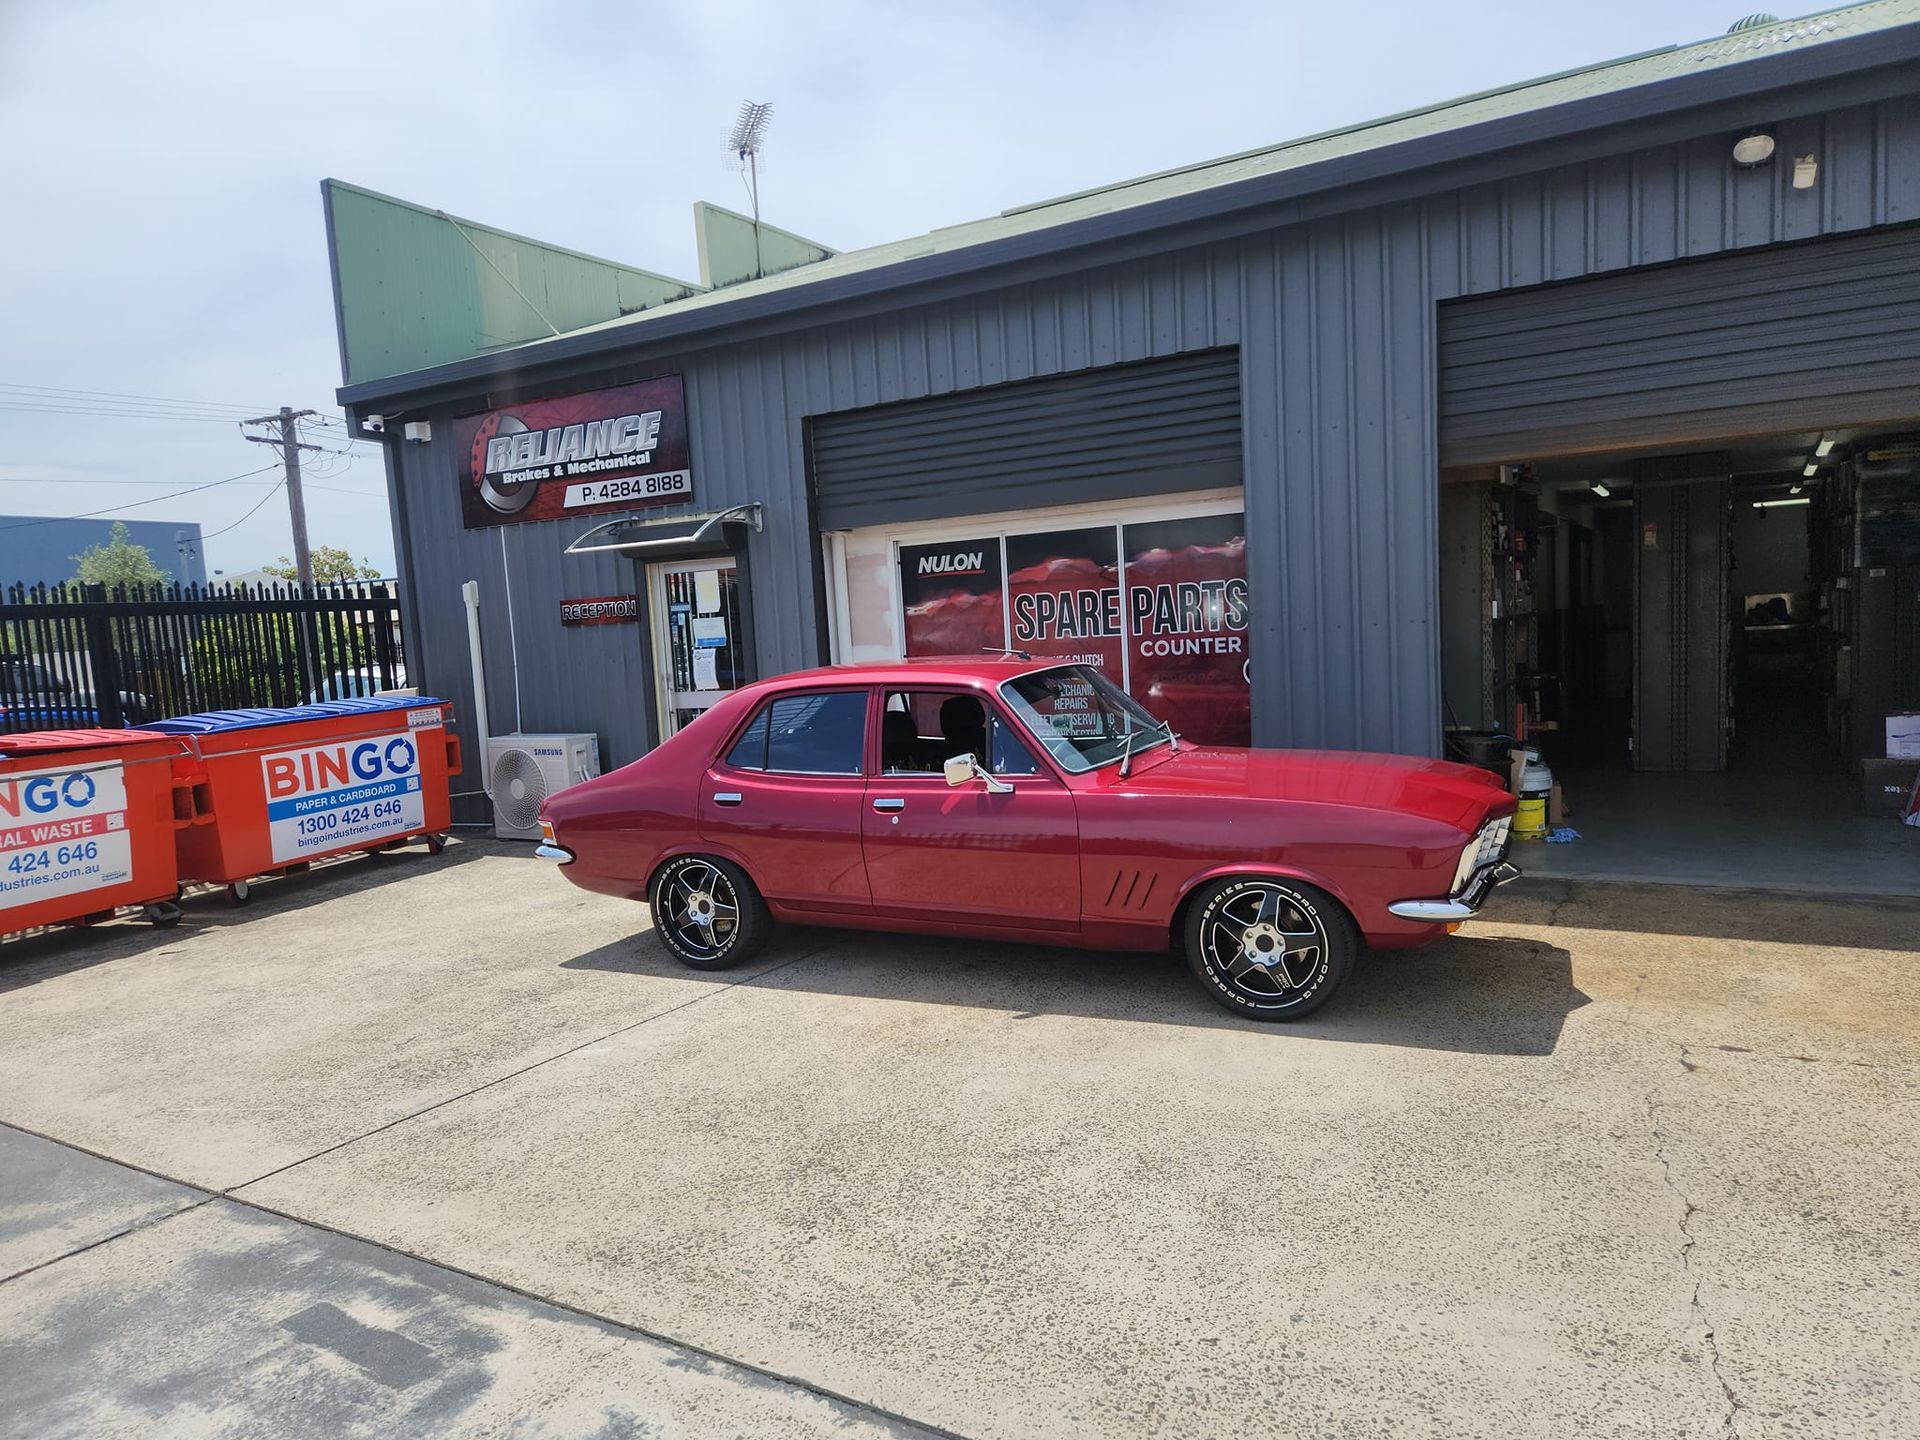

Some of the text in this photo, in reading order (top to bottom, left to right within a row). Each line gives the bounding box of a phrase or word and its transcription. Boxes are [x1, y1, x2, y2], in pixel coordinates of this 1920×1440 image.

[486, 410, 662, 474] RELIANCE
[502, 451, 651, 485] Brakes & Mechanical
[582, 474, 684, 501] P: 4284 8188
[918, 551, 983, 574] NULON
[561, 599, 637, 620] RECEPTION
[1015, 578, 1249, 642] SPARE PARTS
[1140, 636, 1242, 658] COUNTER
[1054, 697, 1088, 711] REPAIRS
[534, 748, 563, 756] SAMSUNG
[266, 737, 415, 799] BINGO
[296, 783, 397, 812] PAPER & CARDBOARD
[30, 819, 93, 842] WASTE
[297, 799, 401, 835] 1300 424 646
[297, 817, 403, 848] bingoindustries.com.au
[8, 841, 98, 874] 424 646
[1203, 882, 1244, 920] SERIES
[1292, 892, 1317, 916] PRO
[1206, 965, 1256, 1008] FORGED
[1302, 964, 1329, 1000] DRAG
